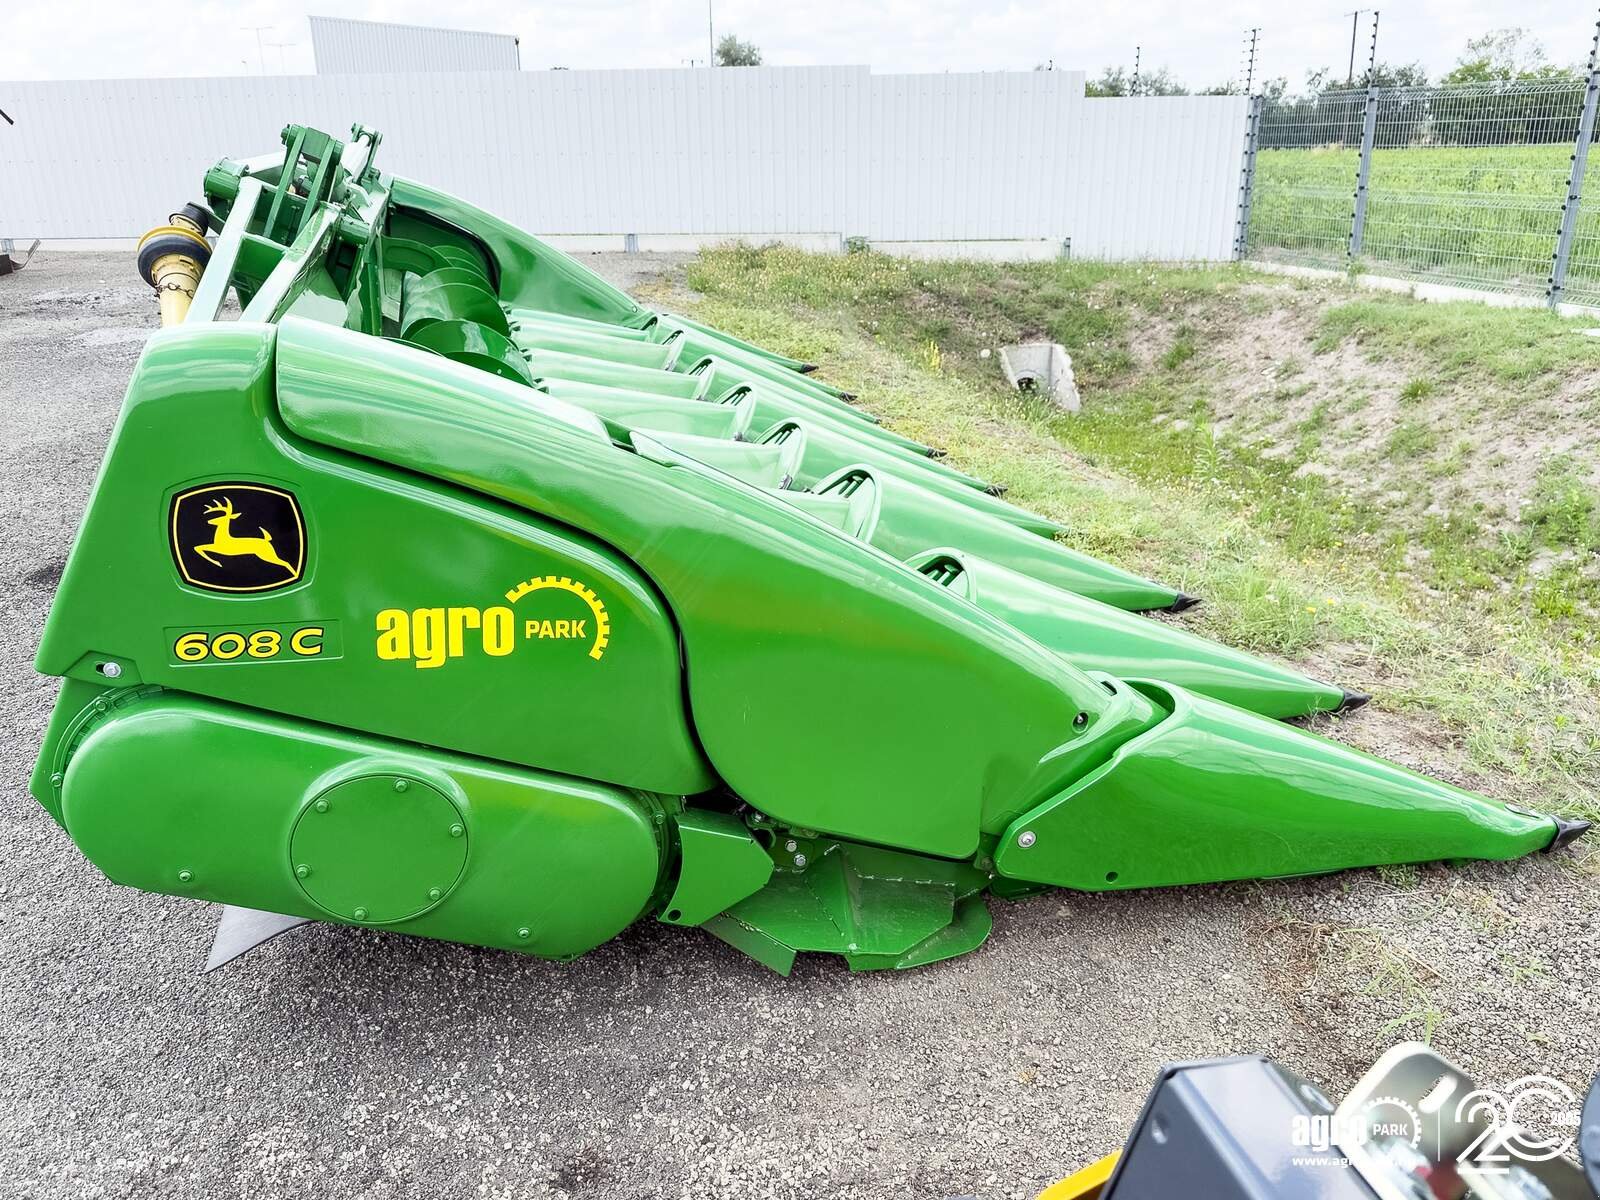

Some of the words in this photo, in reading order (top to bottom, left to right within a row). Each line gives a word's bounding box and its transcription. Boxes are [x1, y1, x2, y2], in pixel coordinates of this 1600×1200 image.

[173, 631, 283, 662] 608
[290, 627, 325, 656] C
[376, 606, 515, 668] agro
[525, 619, 586, 639] PARK
